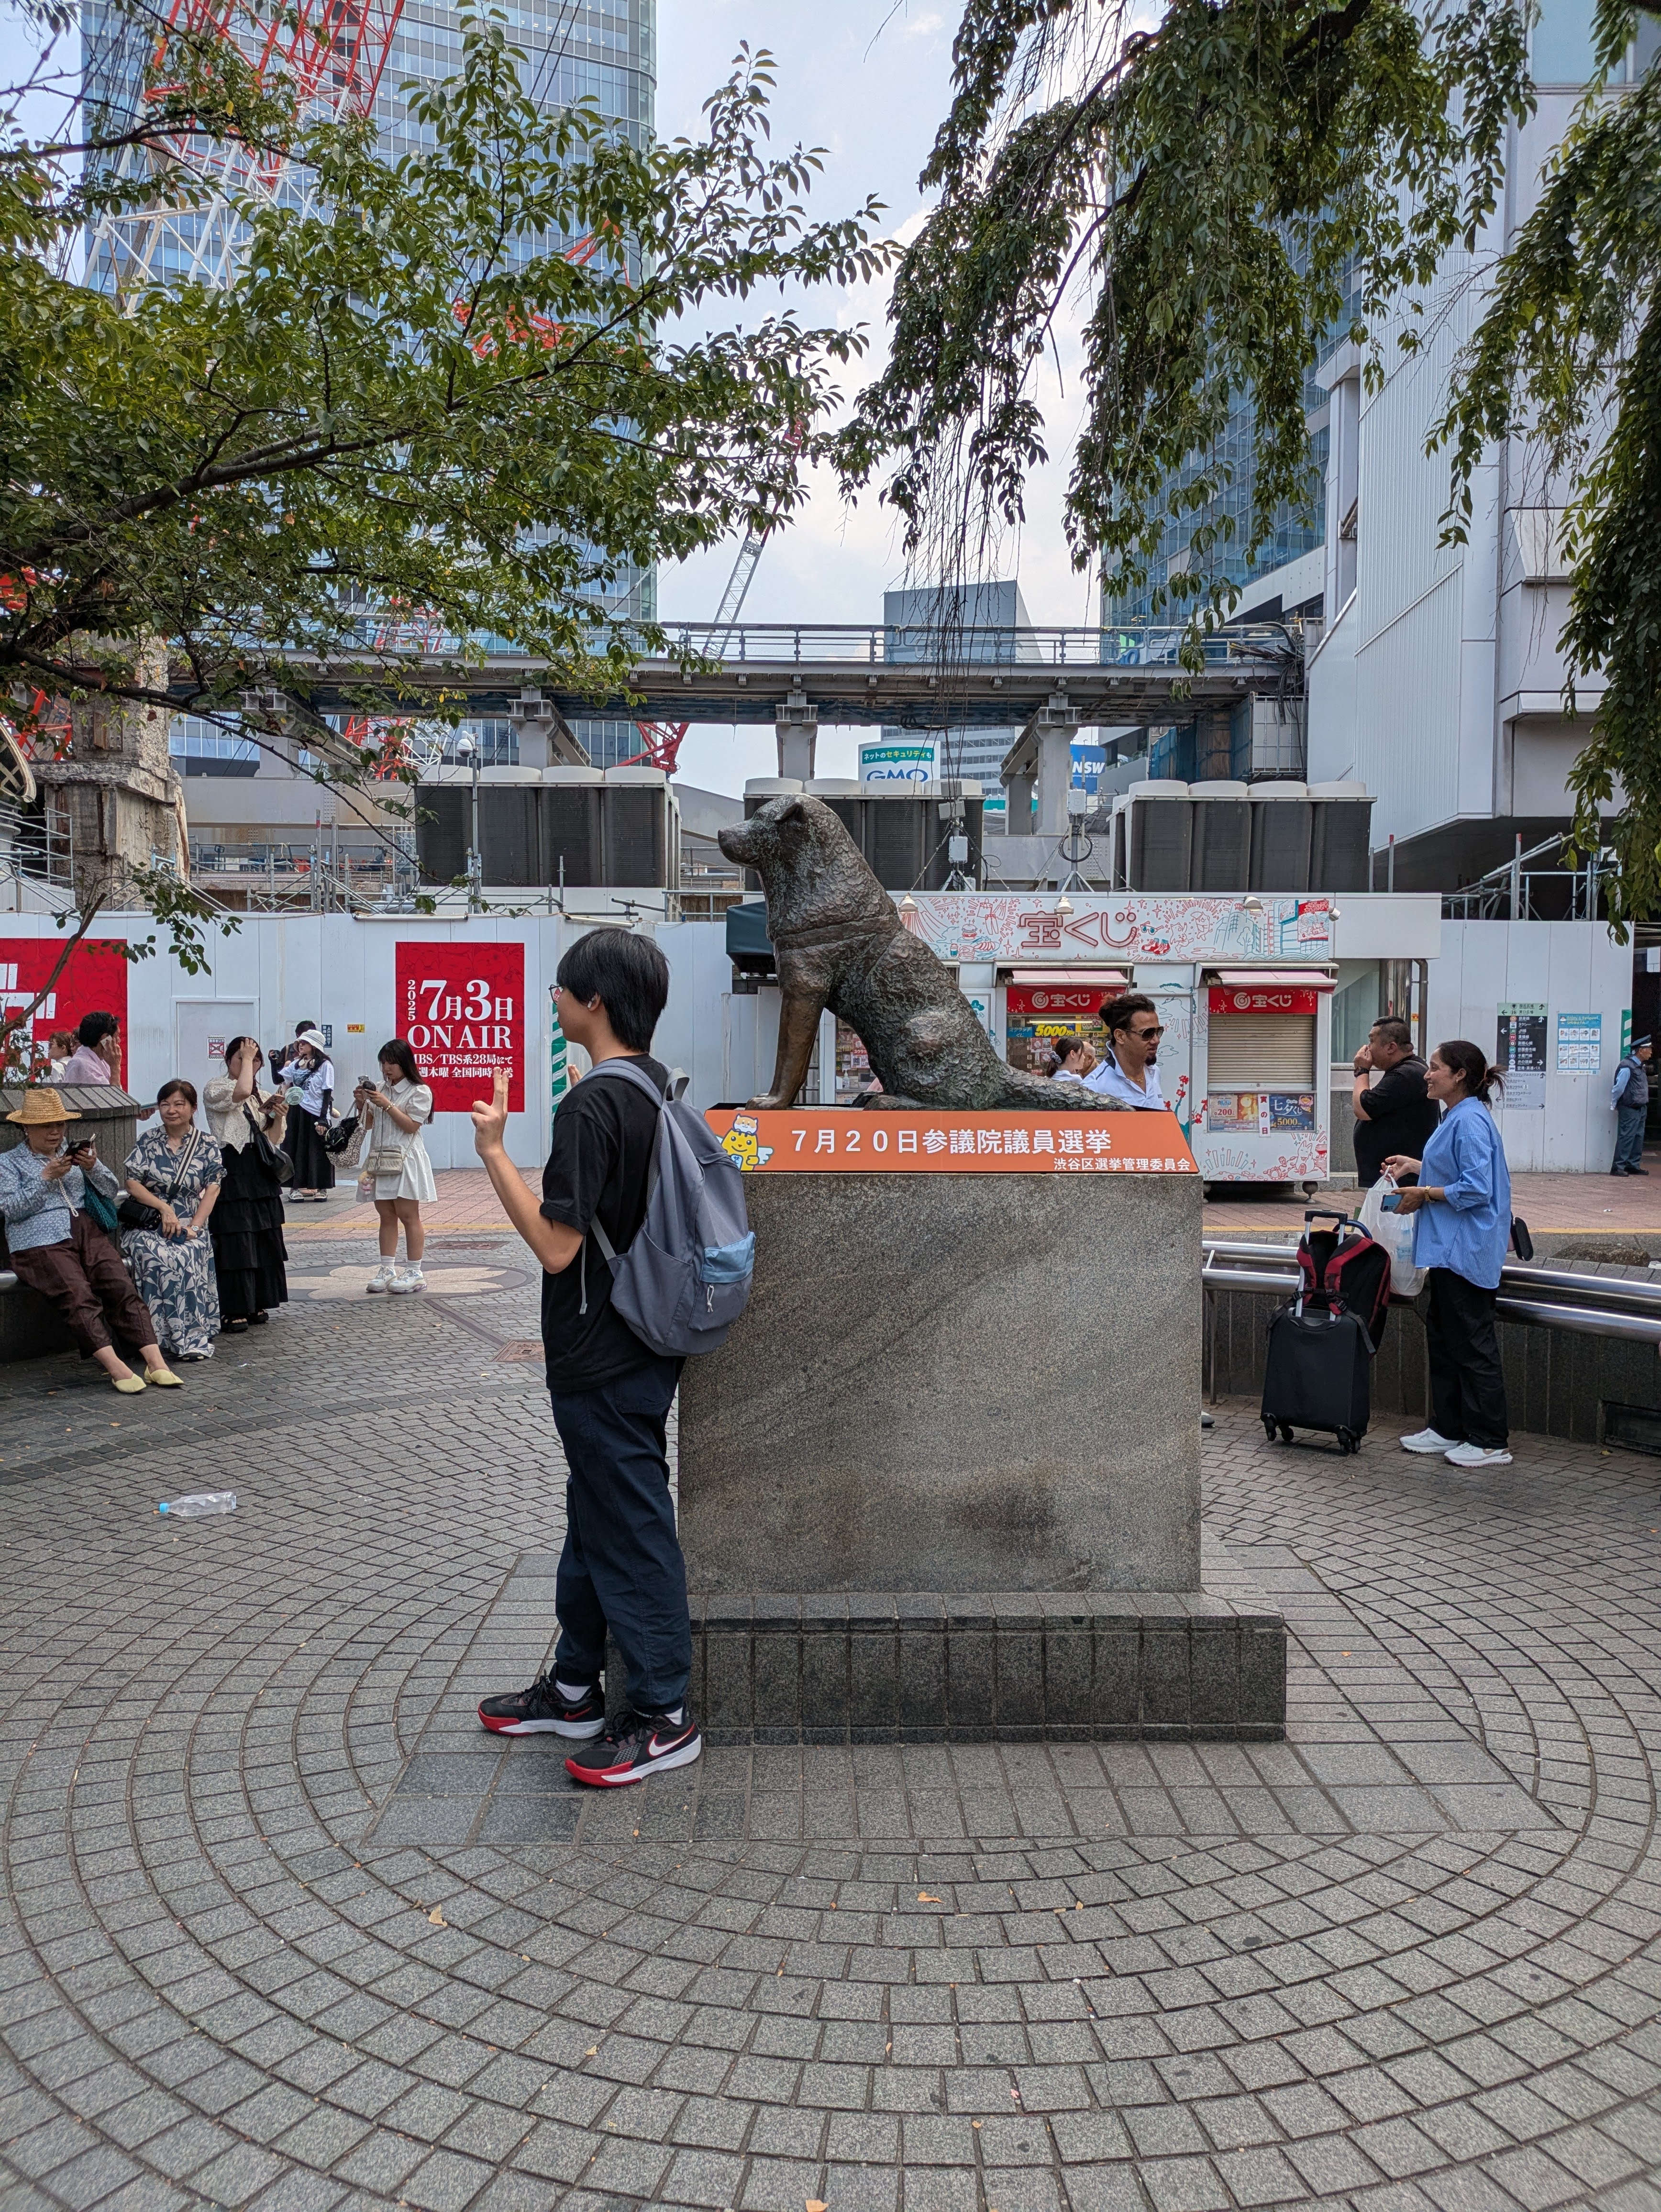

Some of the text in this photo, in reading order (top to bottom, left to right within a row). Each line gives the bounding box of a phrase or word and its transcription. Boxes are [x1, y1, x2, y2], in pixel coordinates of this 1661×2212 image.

[864, 750, 931, 761] ネットのセキュリティも
[1072, 761, 1106, 774] NSW
[866, 769, 928, 782] GMO
[1019, 910, 1137, 948] 宝くじ
[408, 980, 416, 1021] 2025
[420, 980, 513, 1021] 7月3日
[1051, 994, 1090, 1006] 宝くじ
[1252, 995, 1292, 1007] 宝くじ
[408, 1025, 513, 1049] ON AIR
[792, 1129, 1111, 1154] 7月20日参議院議員選挙
[1053, 1158, 1190, 1171] 渋谷区選挙管理委員会
